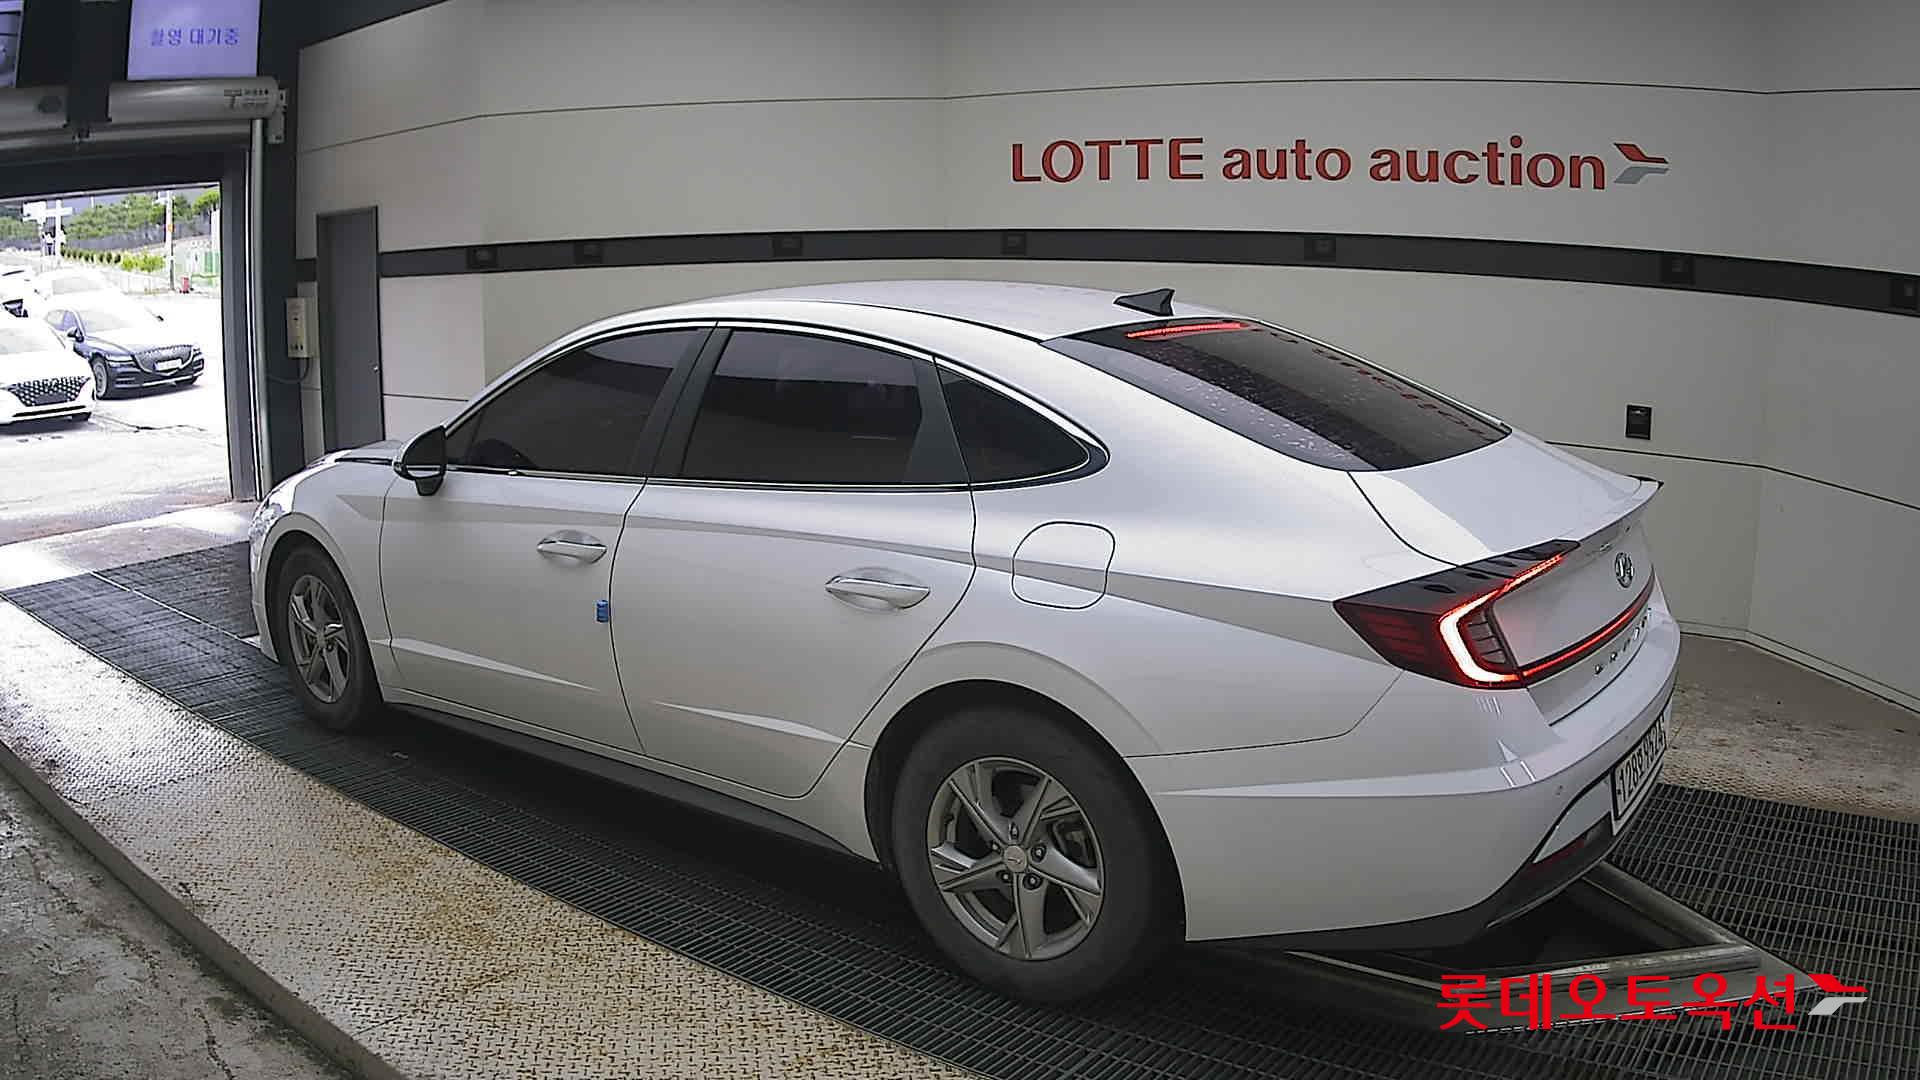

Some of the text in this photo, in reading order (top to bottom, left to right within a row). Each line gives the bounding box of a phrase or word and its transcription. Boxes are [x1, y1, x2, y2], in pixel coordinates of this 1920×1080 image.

[189, 27, 241, 47] 대기중
[1011, 135, 1606, 190] LOTTE auto auction
